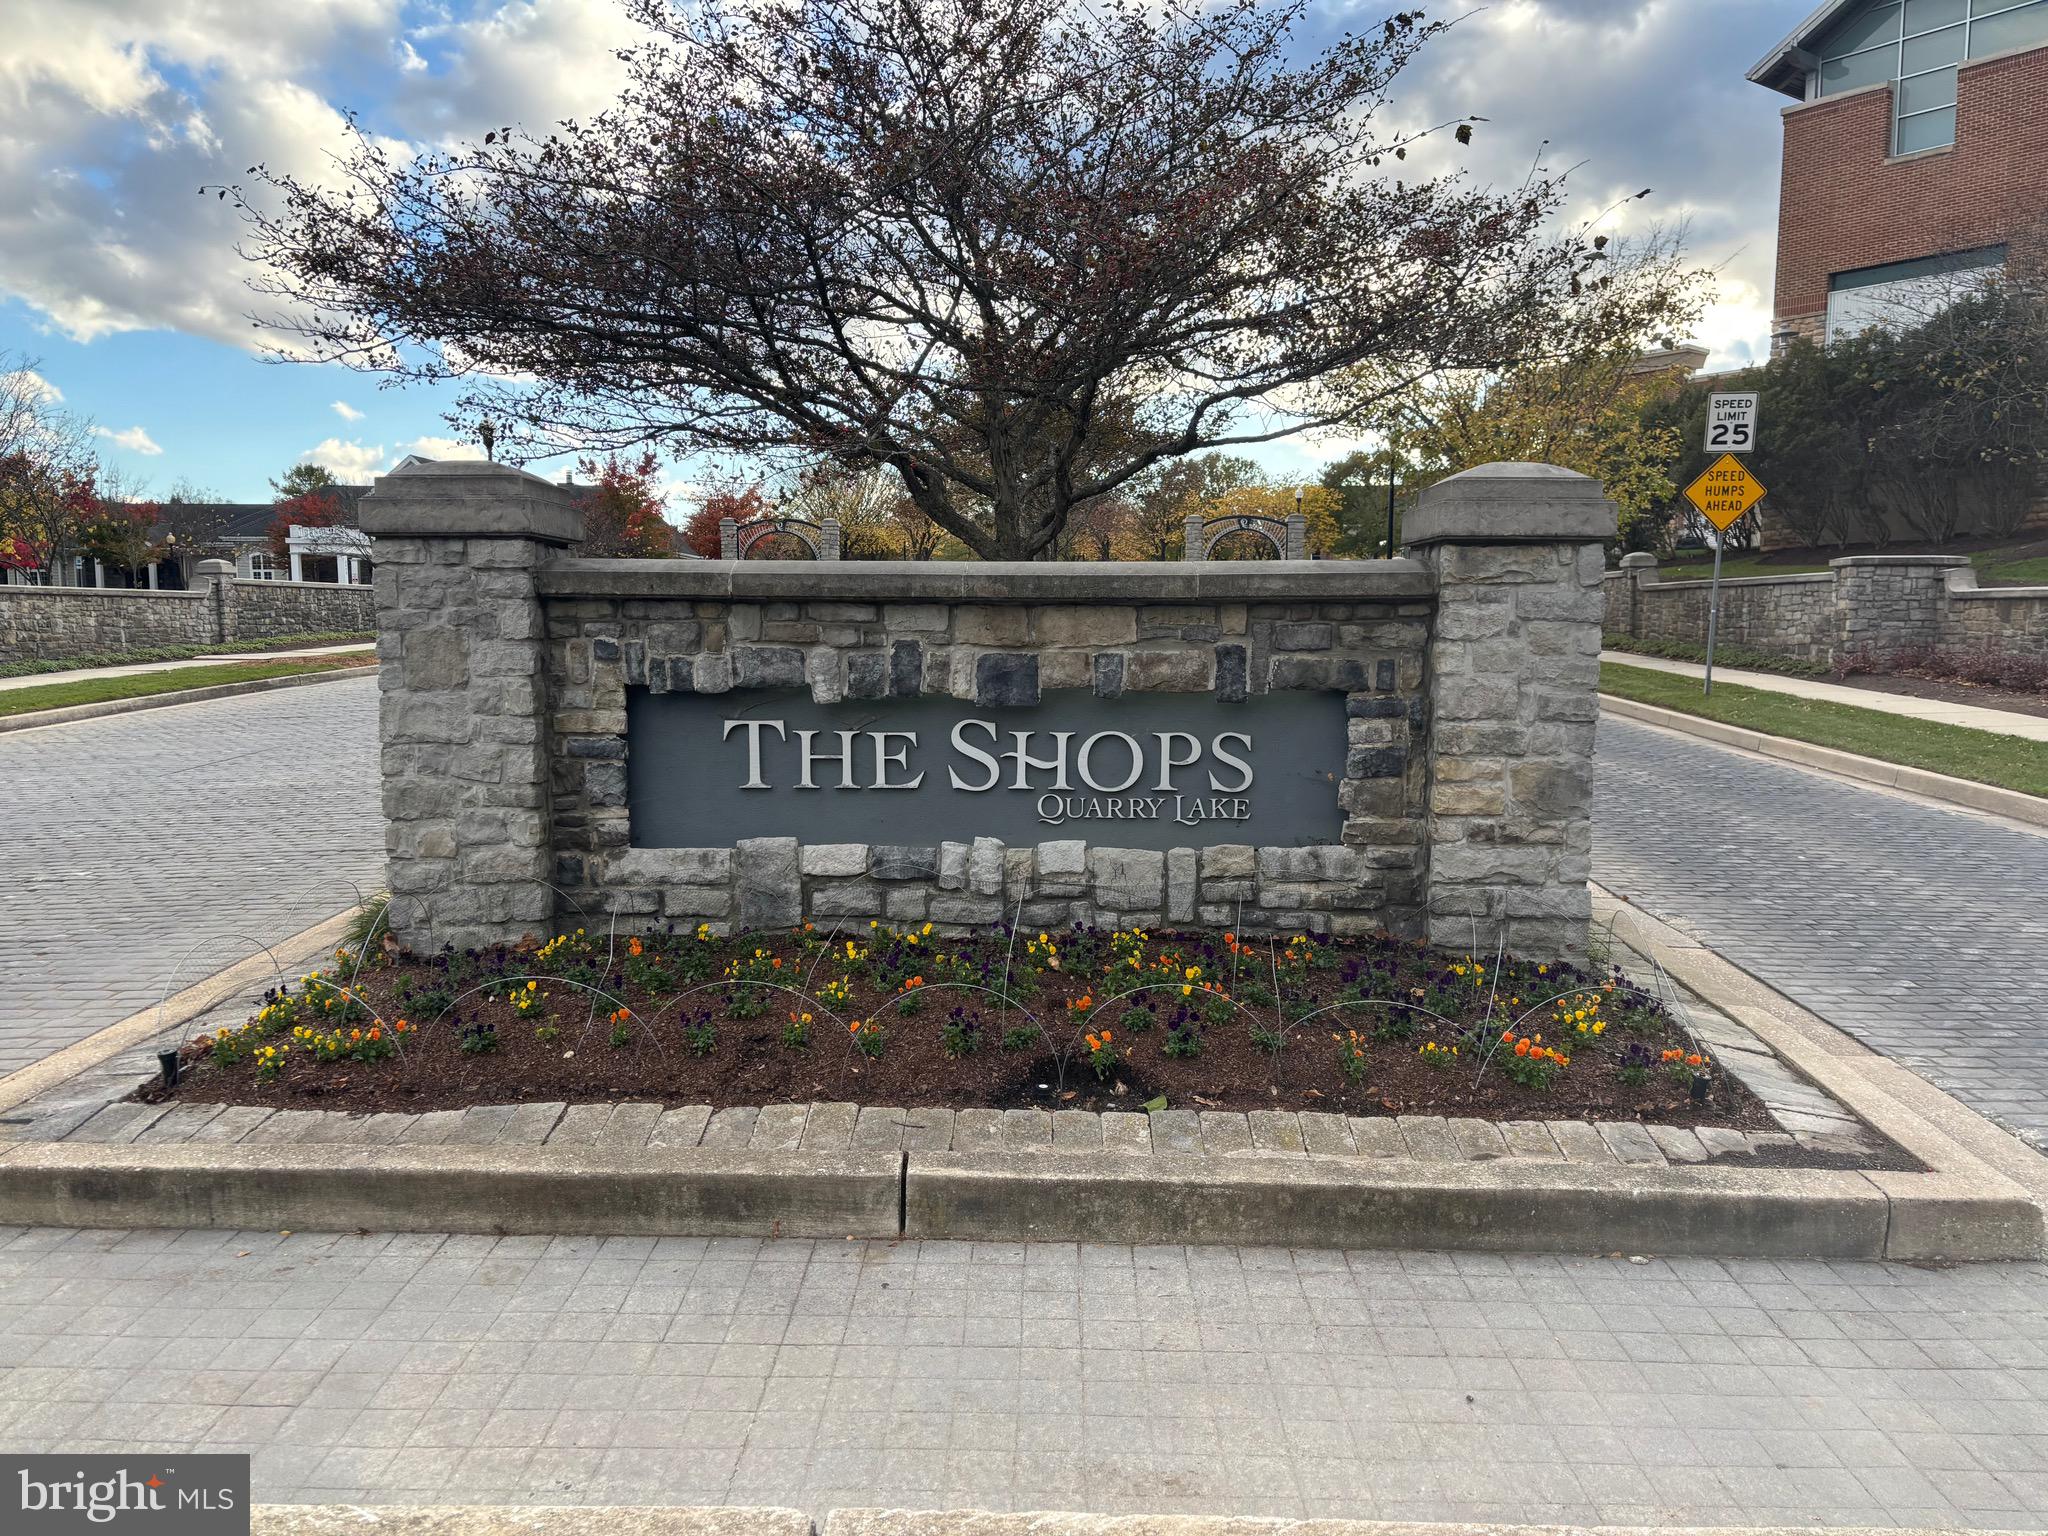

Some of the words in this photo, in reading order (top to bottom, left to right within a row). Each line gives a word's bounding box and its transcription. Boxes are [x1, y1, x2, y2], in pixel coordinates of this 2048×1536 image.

[1714, 400, 1752, 409] SPEED
[1717, 412, 1747, 421] LIMIT
[1710, 424, 1749, 445] 25
[1708, 471, 1745, 481] SPEED
[1705, 486, 1745, 496] HUMPS
[1705, 500, 1742, 511] AHEAD
[723, 719, 926, 790] THE
[948, 719, 1254, 793] SHOPS
[1037, 793, 1167, 825] QUARRY
[1173, 794, 1251, 826] LAKE
